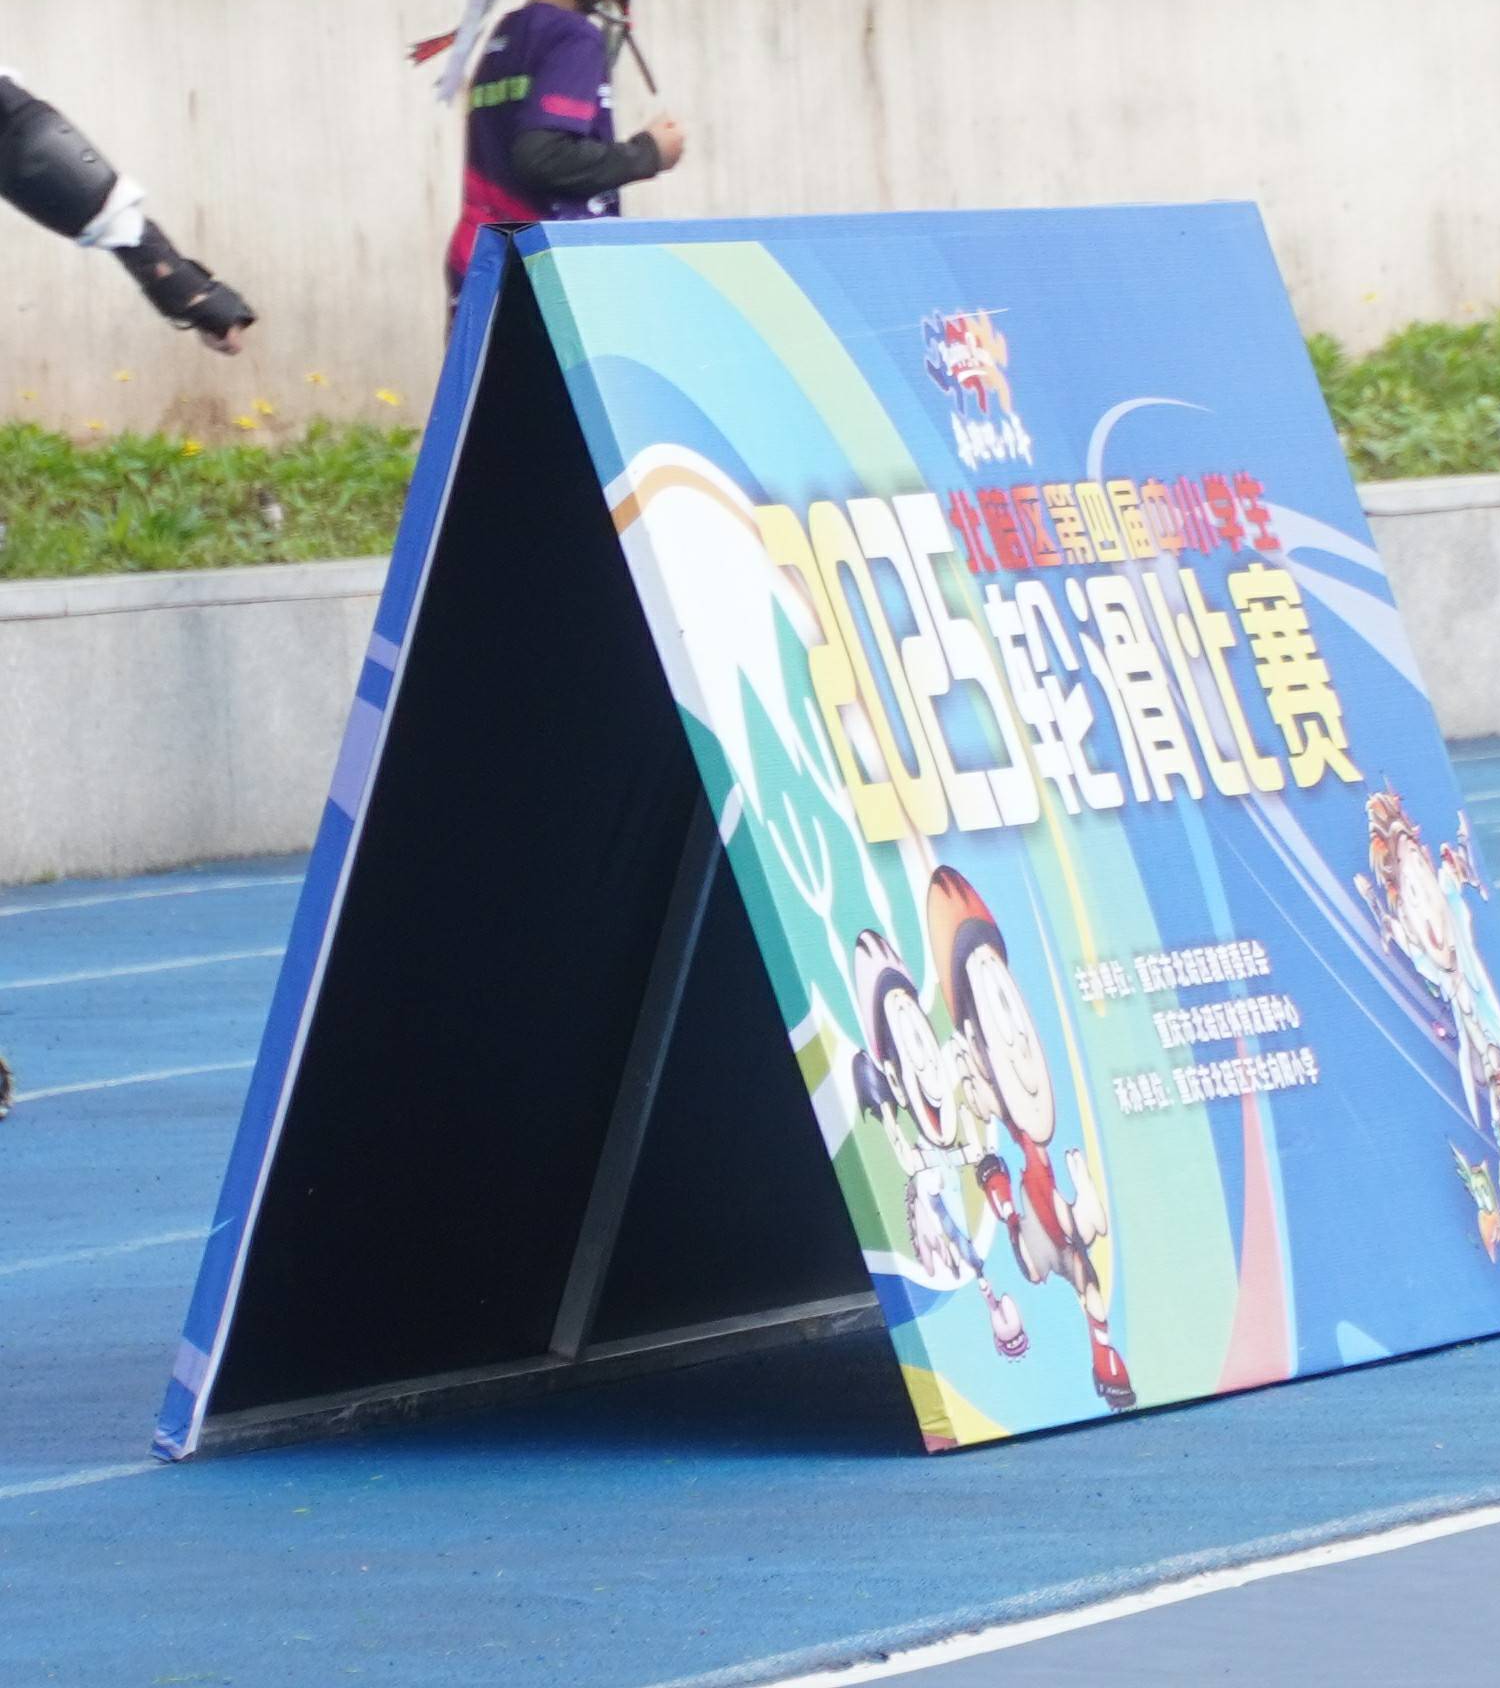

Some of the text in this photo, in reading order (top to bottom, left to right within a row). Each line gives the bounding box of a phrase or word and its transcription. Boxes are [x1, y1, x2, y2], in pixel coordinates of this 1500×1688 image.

[948, 471, 1282, 574] 北碚区第四届中小学生
[755, 491, 1364, 844] 2025轮滑比赛
